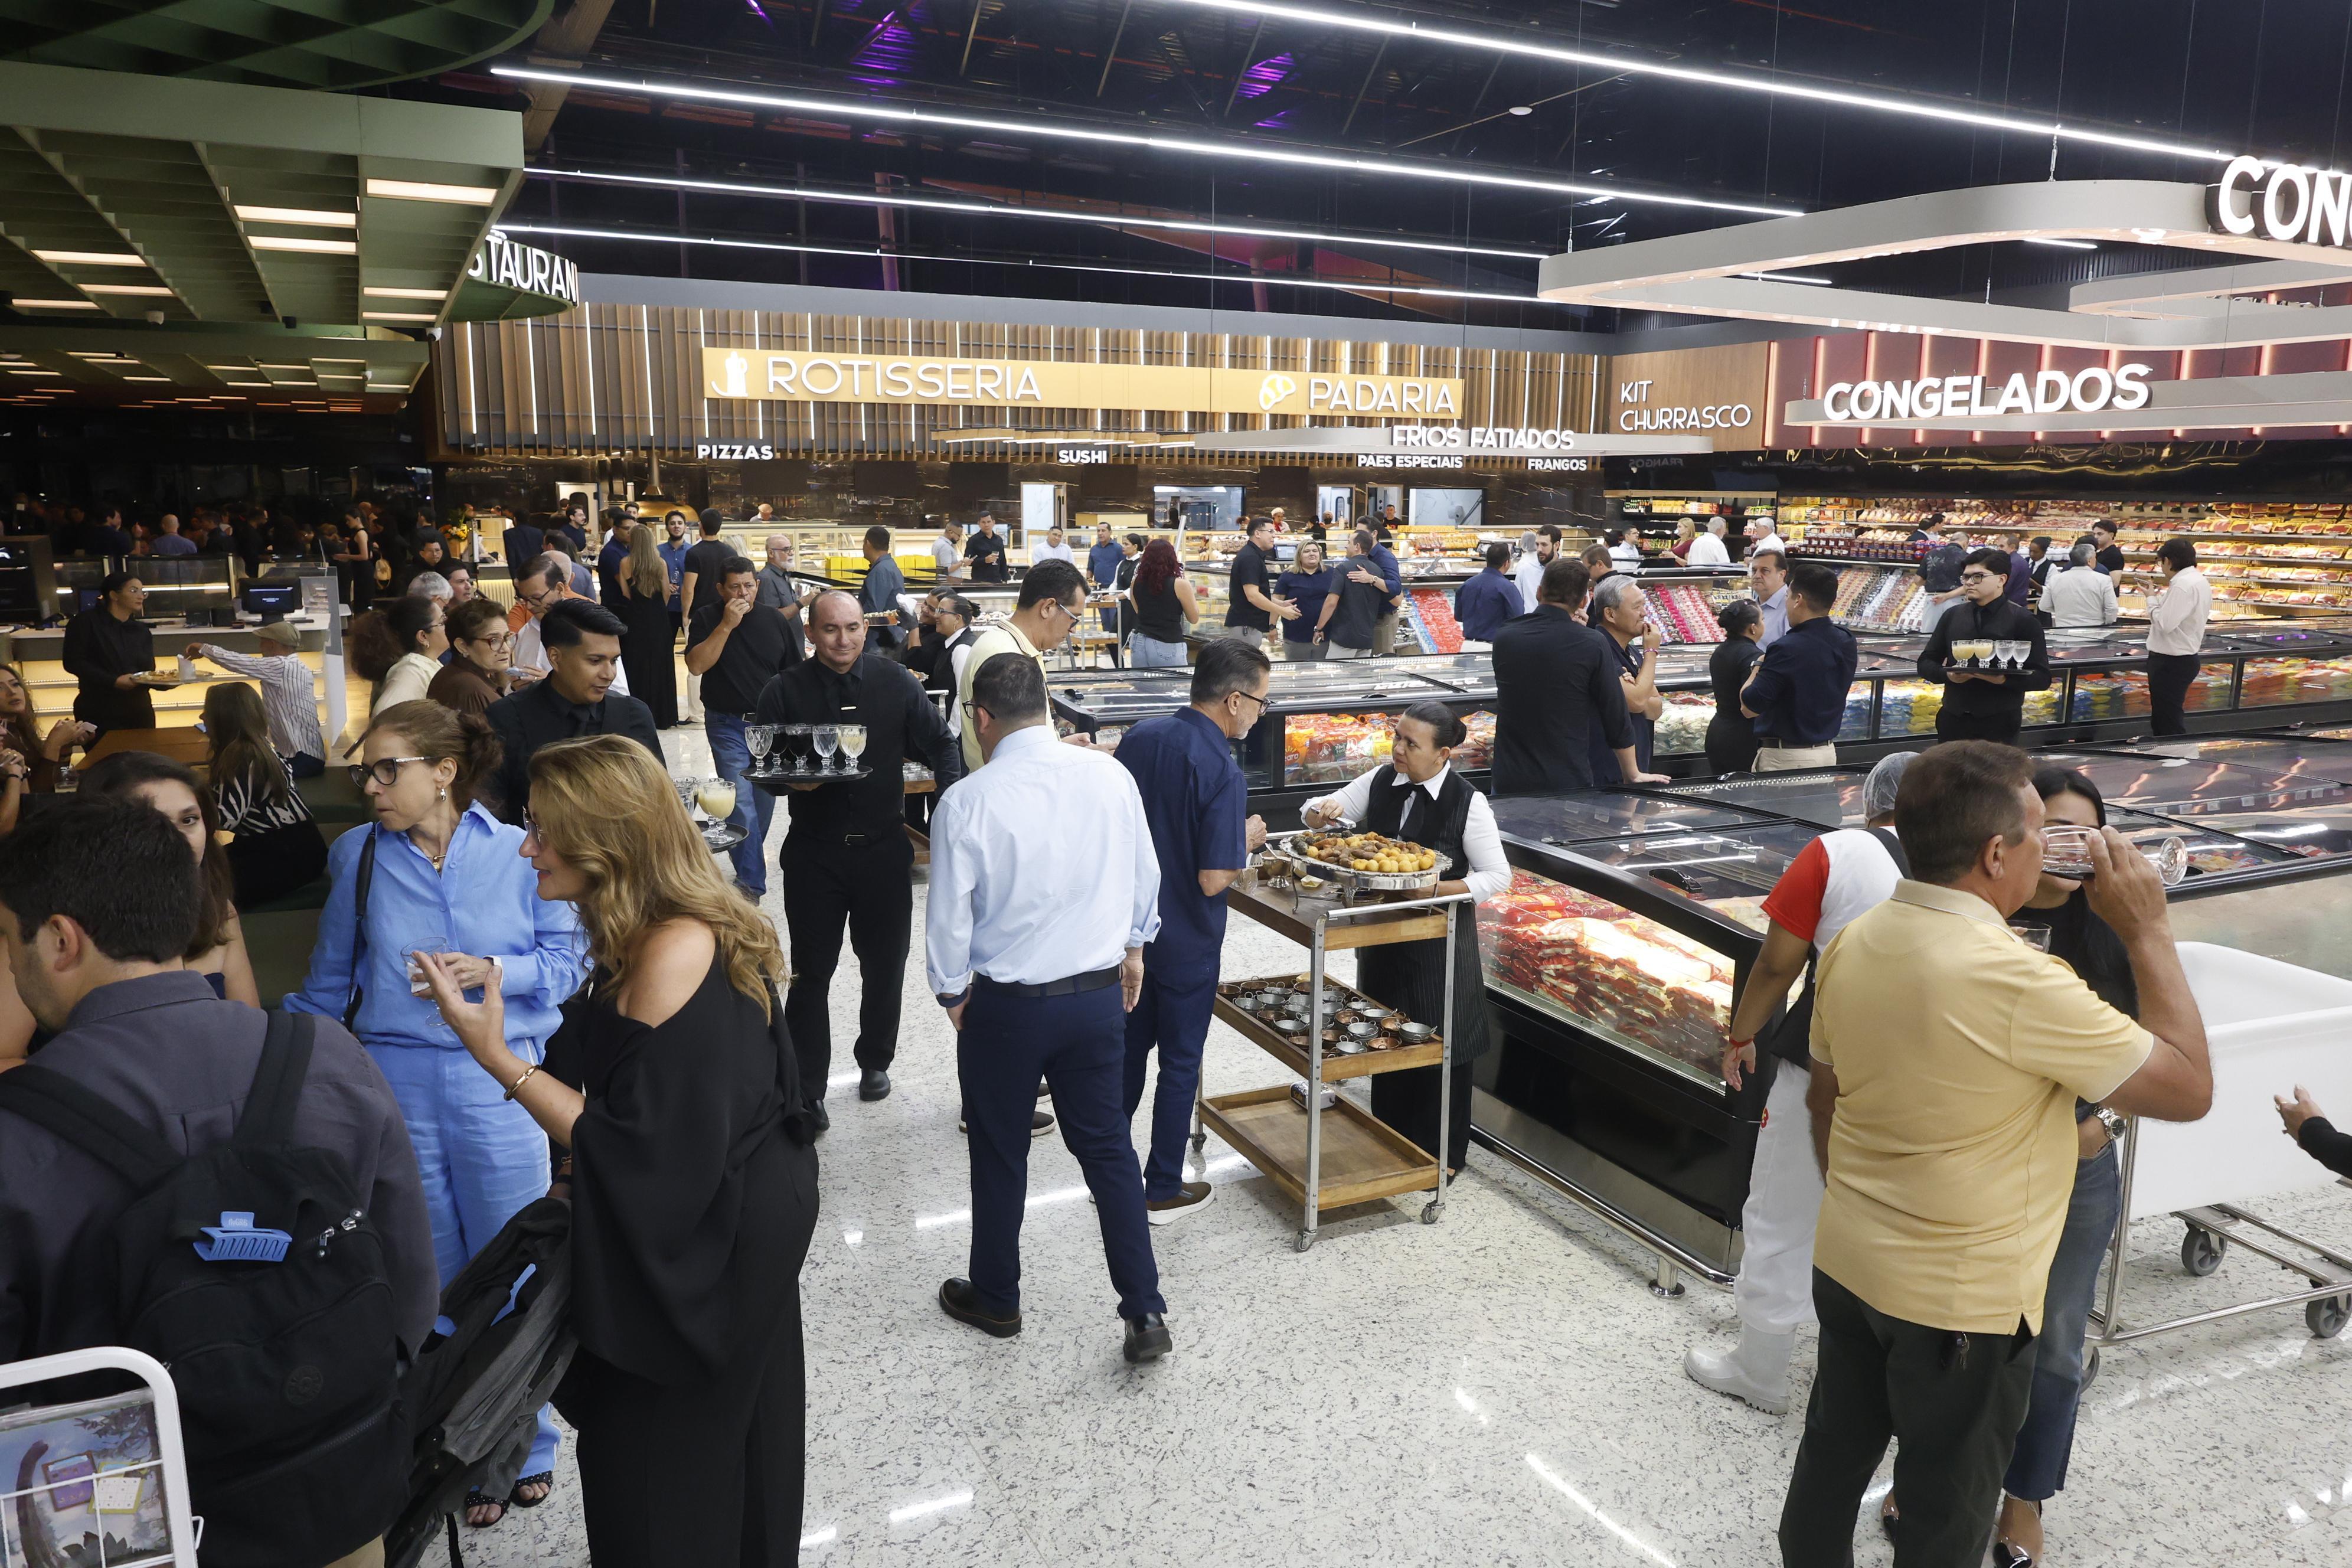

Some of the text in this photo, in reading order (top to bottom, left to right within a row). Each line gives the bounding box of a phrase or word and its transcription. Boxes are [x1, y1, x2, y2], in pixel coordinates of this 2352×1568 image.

[2218, 155, 2352, 246] CON
[768, 357, 1041, 401] ROTISSERIA
[1620, 380, 1653, 403] KIT
[1309, 377, 1456, 414] PADARIA
[1824, 363, 2153, 421] CONGELADOS
[1619, 404, 1752, 432] CHURRASCO
[1393, 425, 1574, 450] FRIOS FATIADOS
[697, 445, 773, 460] PIZZAS
[1059, 449, 1108, 464] SUSHI
[1358, 455, 1464, 469] PAES ESPECIAIS
[1528, 458, 1587, 471] FRANGOS
